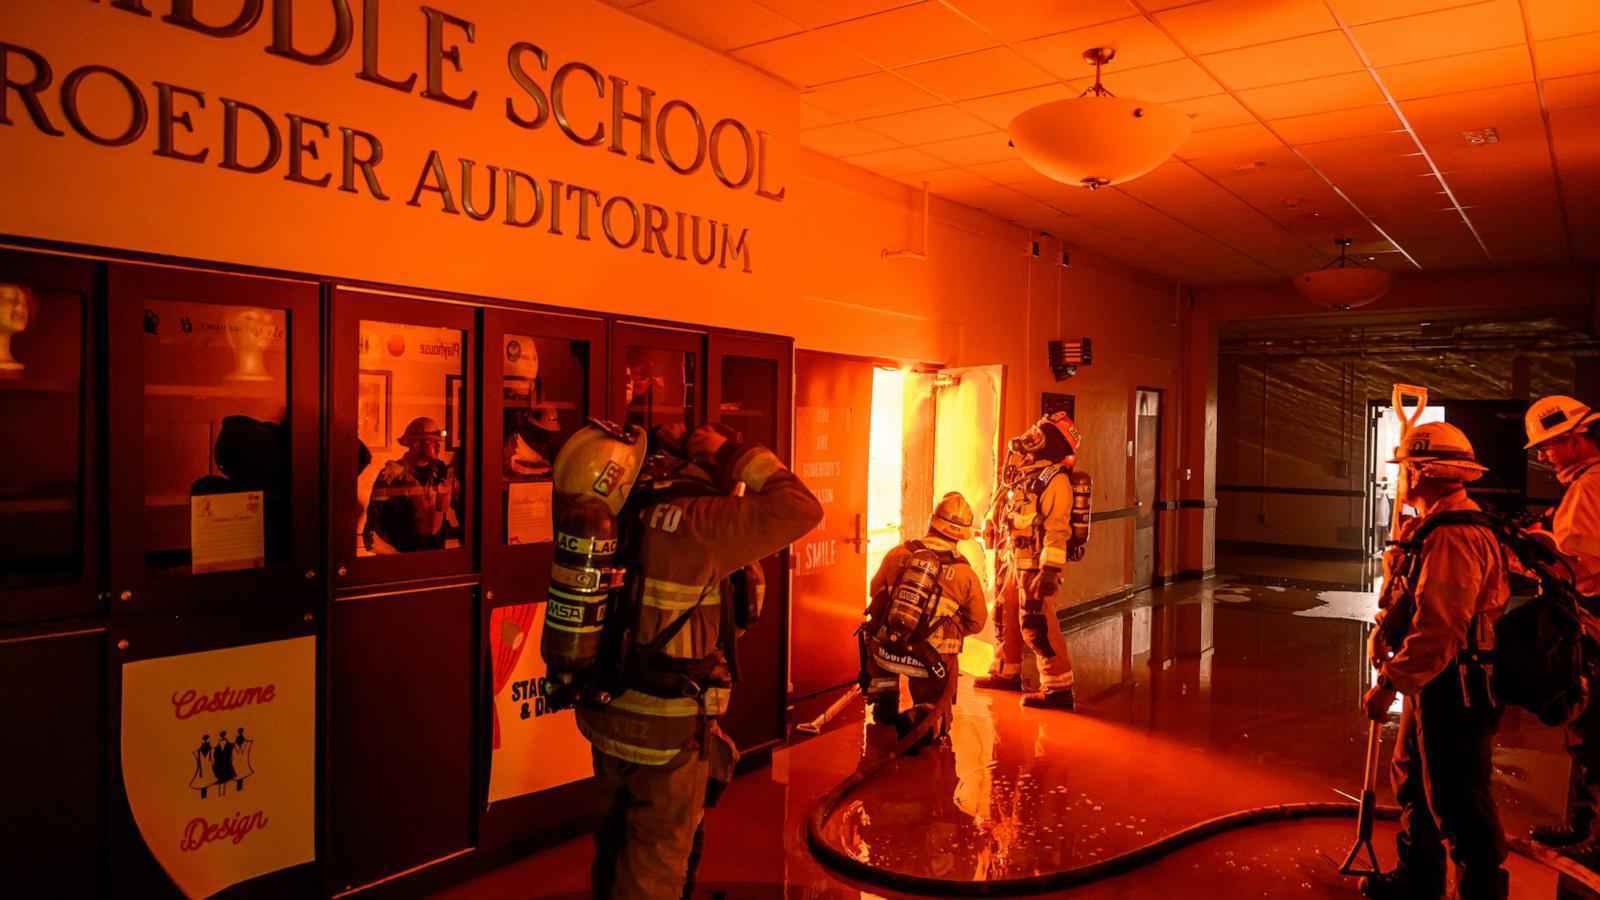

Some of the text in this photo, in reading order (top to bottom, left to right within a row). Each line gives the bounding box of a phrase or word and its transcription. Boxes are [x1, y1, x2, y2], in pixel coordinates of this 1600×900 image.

[506, 42, 785, 201] SCHOOL
[406, 150, 753, 274] AUDITORIUM
[650, 504, 682, 533] FD
[805, 540, 837, 570] SMILE
[171, 684, 276, 720] Costume
[179, 810, 269, 852] Design
